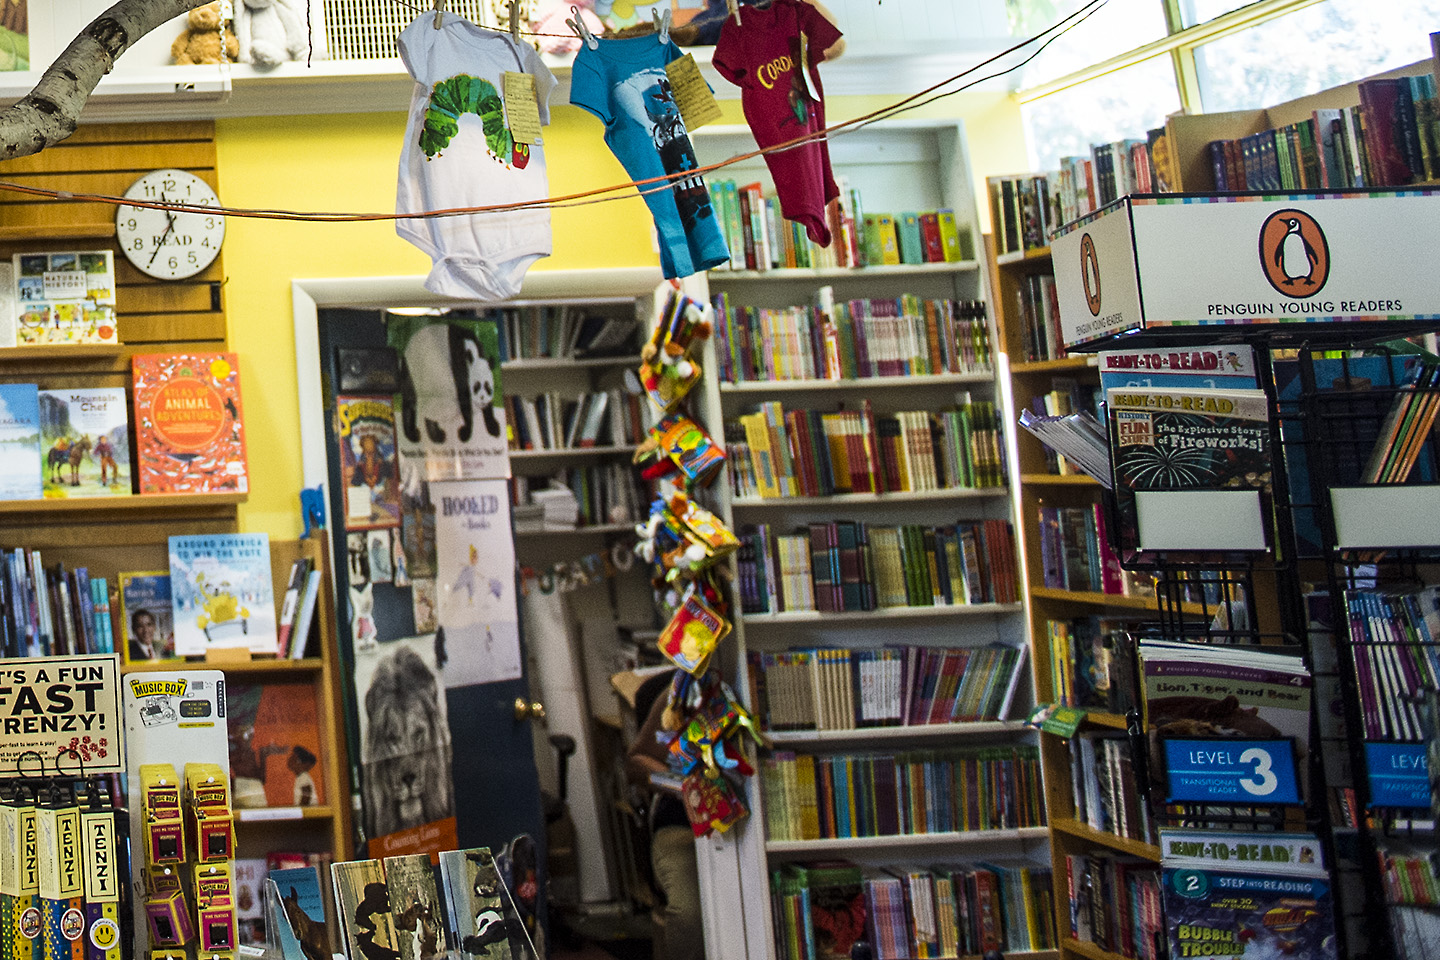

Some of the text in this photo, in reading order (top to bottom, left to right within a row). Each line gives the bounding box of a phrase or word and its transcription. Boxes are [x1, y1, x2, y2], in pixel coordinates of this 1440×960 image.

[145, 186, 156, 197] 11
[163, 180, 176, 192] 12
[186, 185, 191, 196] 1
[127, 219, 137, 231] 9
[205, 217, 214, 230] 3
[133, 238, 143, 250] 8
[153, 235, 193, 247] READ
[201, 237, 209, 248] 4
[168, 256, 178, 269] 6
[187, 251, 197, 263] 5
[45, 272, 84, 282] NATURAL
[45, 281, 84, 289] HISTORY
[1208, 299, 1403, 316] PENGUIN YOUNG READERS
[1075, 312, 1124, 337] PENGUIN YOUNG READERS
[70, 393, 118, 405] Mountain
[164, 397, 211, 411] ANIMAL
[80, 402, 108, 413] Chef
[155, 410, 221, 423] ADVENTURES
[1118, 411, 1150, 420] HISTORY
[1120, 422, 1149, 434] FUN
[1158, 425, 1263, 437] The Explosive Story
[1121, 434, 1151, 445] STUFF
[1158, 434, 1263, 452] of Fireworks!
[442, 495, 499, 516] HOOKED
[177, 539, 263, 549] AROUND AMERICA
[216, 549, 234, 557] THE
[239, 548, 262, 557] VOTE
[35, 669, 50, 684] A
[59, 666, 104, 682] FUN
[1290, 676, 1304, 686] 4
[134, 683, 183, 696] MUSIC BOX
[1156, 683, 1302, 701] Lion, Tiger, and Bear
[1190, 747, 1278, 796] LEVEL 3
[1180, 778, 1238, 787] TRANSITIONAL
[1209, 786, 1238, 794] READER
[199, 793, 224, 802] MUSIC BOX
[25, 817, 37, 884] TENZI
[62, 819, 75, 887] TENZI
[94, 824, 108, 891] TENZI
[1186, 875, 1200, 891] 2
[1219, 877, 1312, 892] STEP INTO READING
[1178, 925, 1233, 942] BUBBLE
